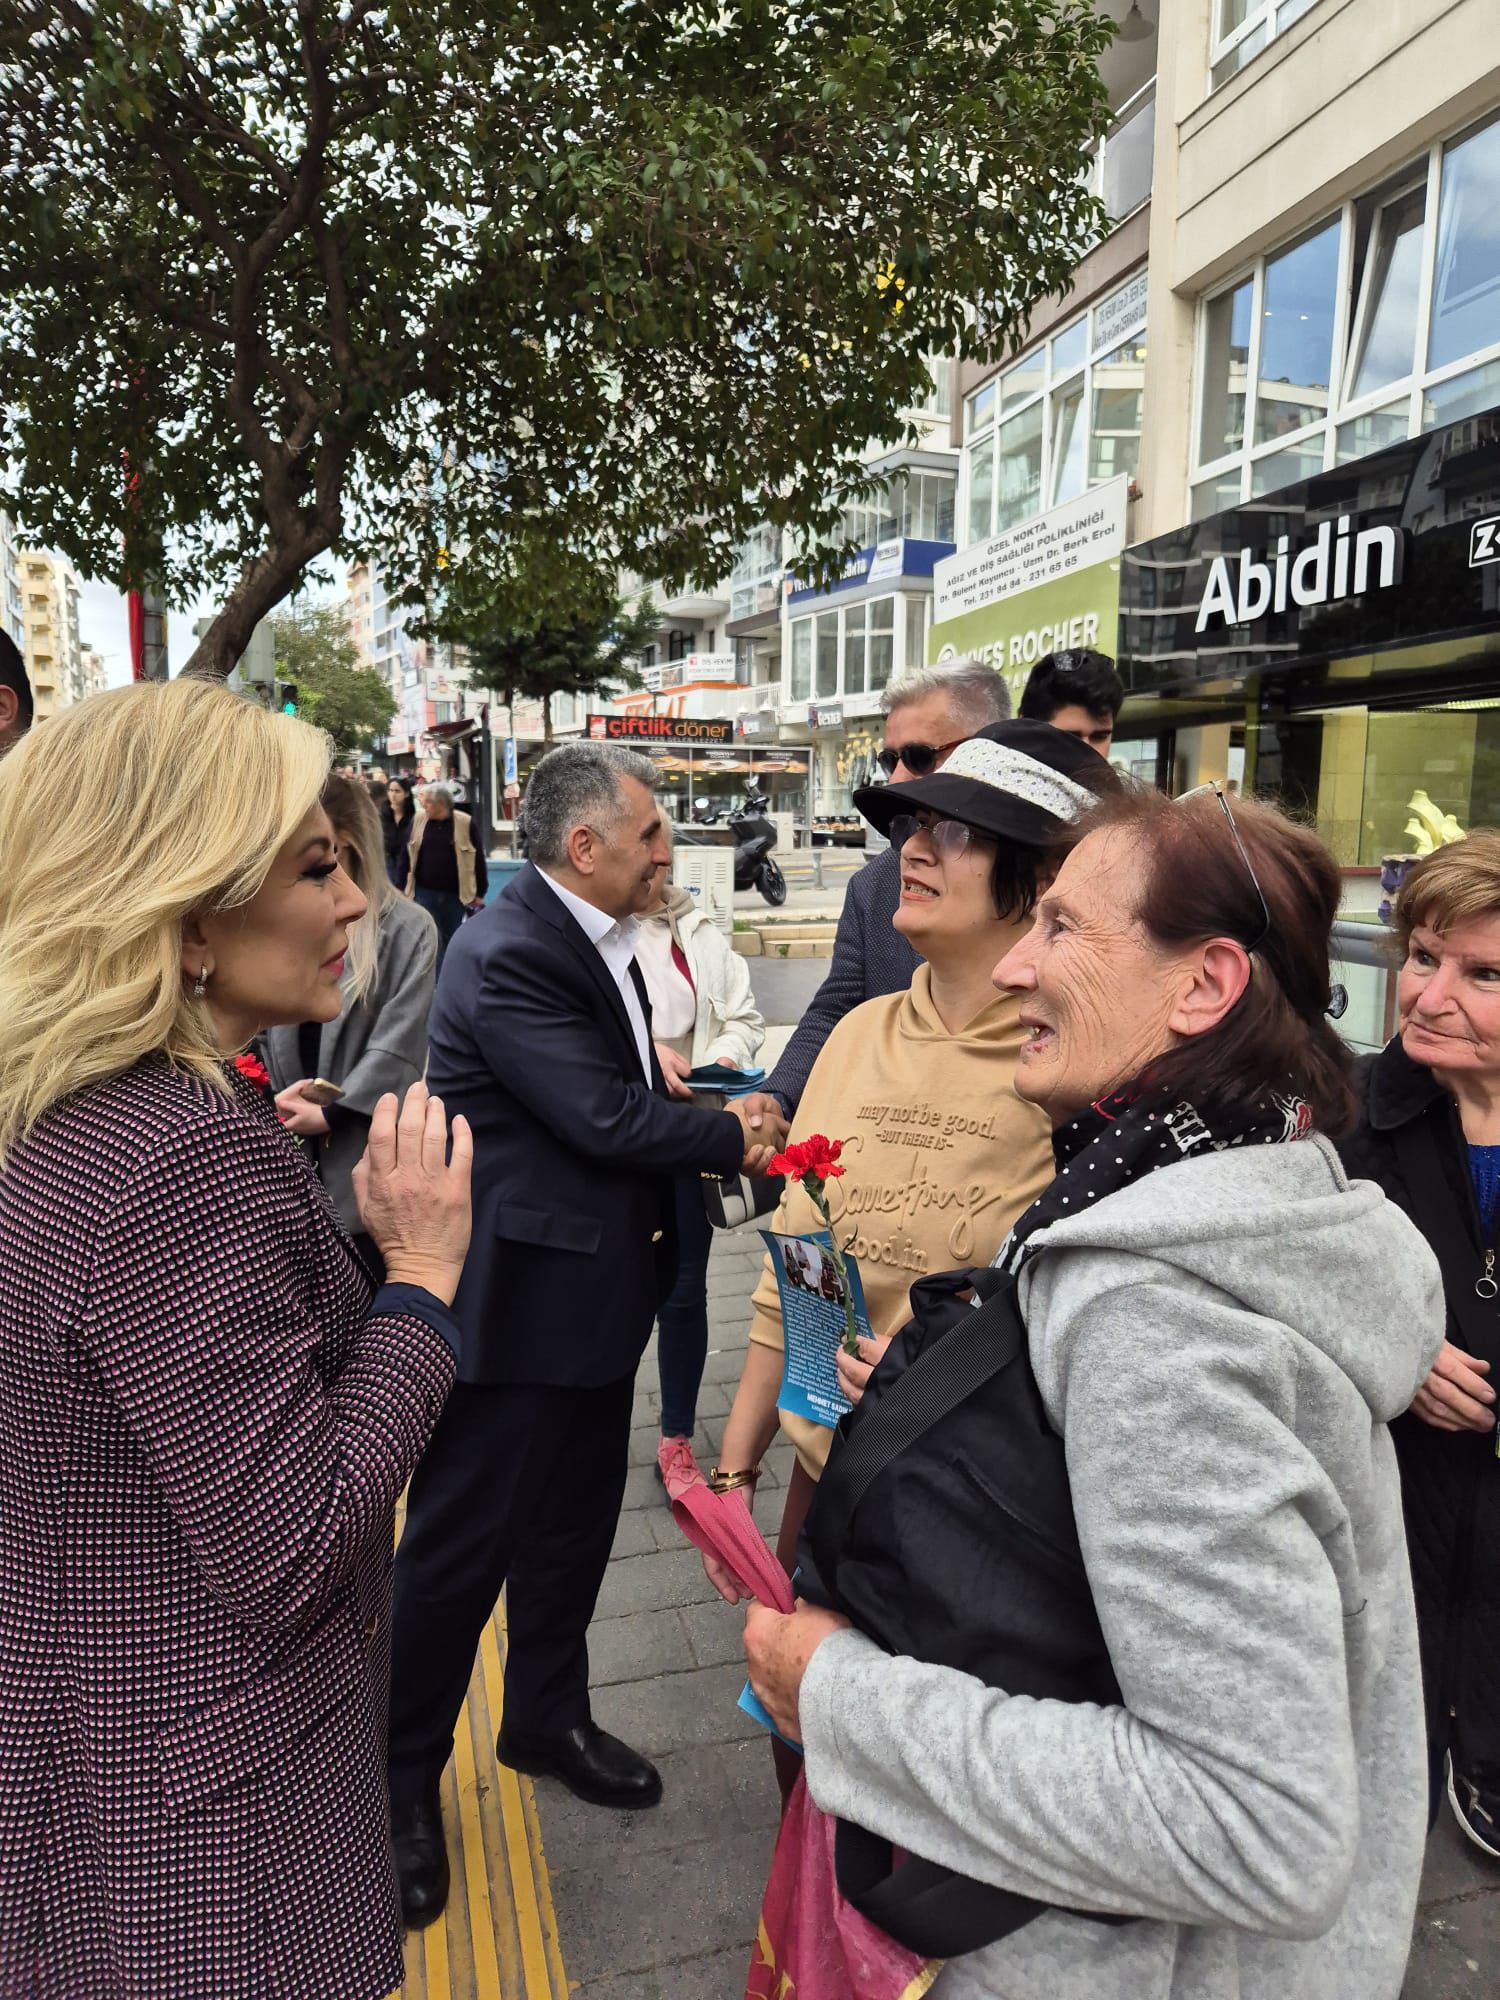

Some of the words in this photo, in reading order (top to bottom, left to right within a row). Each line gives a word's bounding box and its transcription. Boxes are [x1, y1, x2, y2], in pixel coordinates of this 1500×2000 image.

[946, 573, 965, 588] AĞIZ
[967, 567, 978, 578] VE
[997, 542, 1034, 566] SAĞLIĞI
[1037, 508, 1104, 548] POLİKLİNİĞİ
[979, 567, 1015, 588] Koyuncu
[1023, 555, 1044, 569] Uzm
[1063, 535, 1088, 553] Berk
[1092, 522, 1115, 541] Erol
[987, 539, 1010, 556] ÖZEL
[1013, 521, 1047, 544] NOKTA
[1029, 567, 1045, 582] 231
[1049, 561, 1062, 574] 65
[1064, 555, 1078, 568] 65
[1195, 514, 1396, 633] Abidin
[1009, 612, 1099, 668] ROCHER
[608, 716, 672, 738] çiftlik
[674, 720, 729, 738] döner
[856, 1104, 890, 1127] may
[889, 1102, 919, 1125] not
[918, 1101, 942, 1128] be
[942, 1112, 998, 1141] good.
[901, 1132, 935, 1149] THERE
[903, 1238, 929, 1274] in
